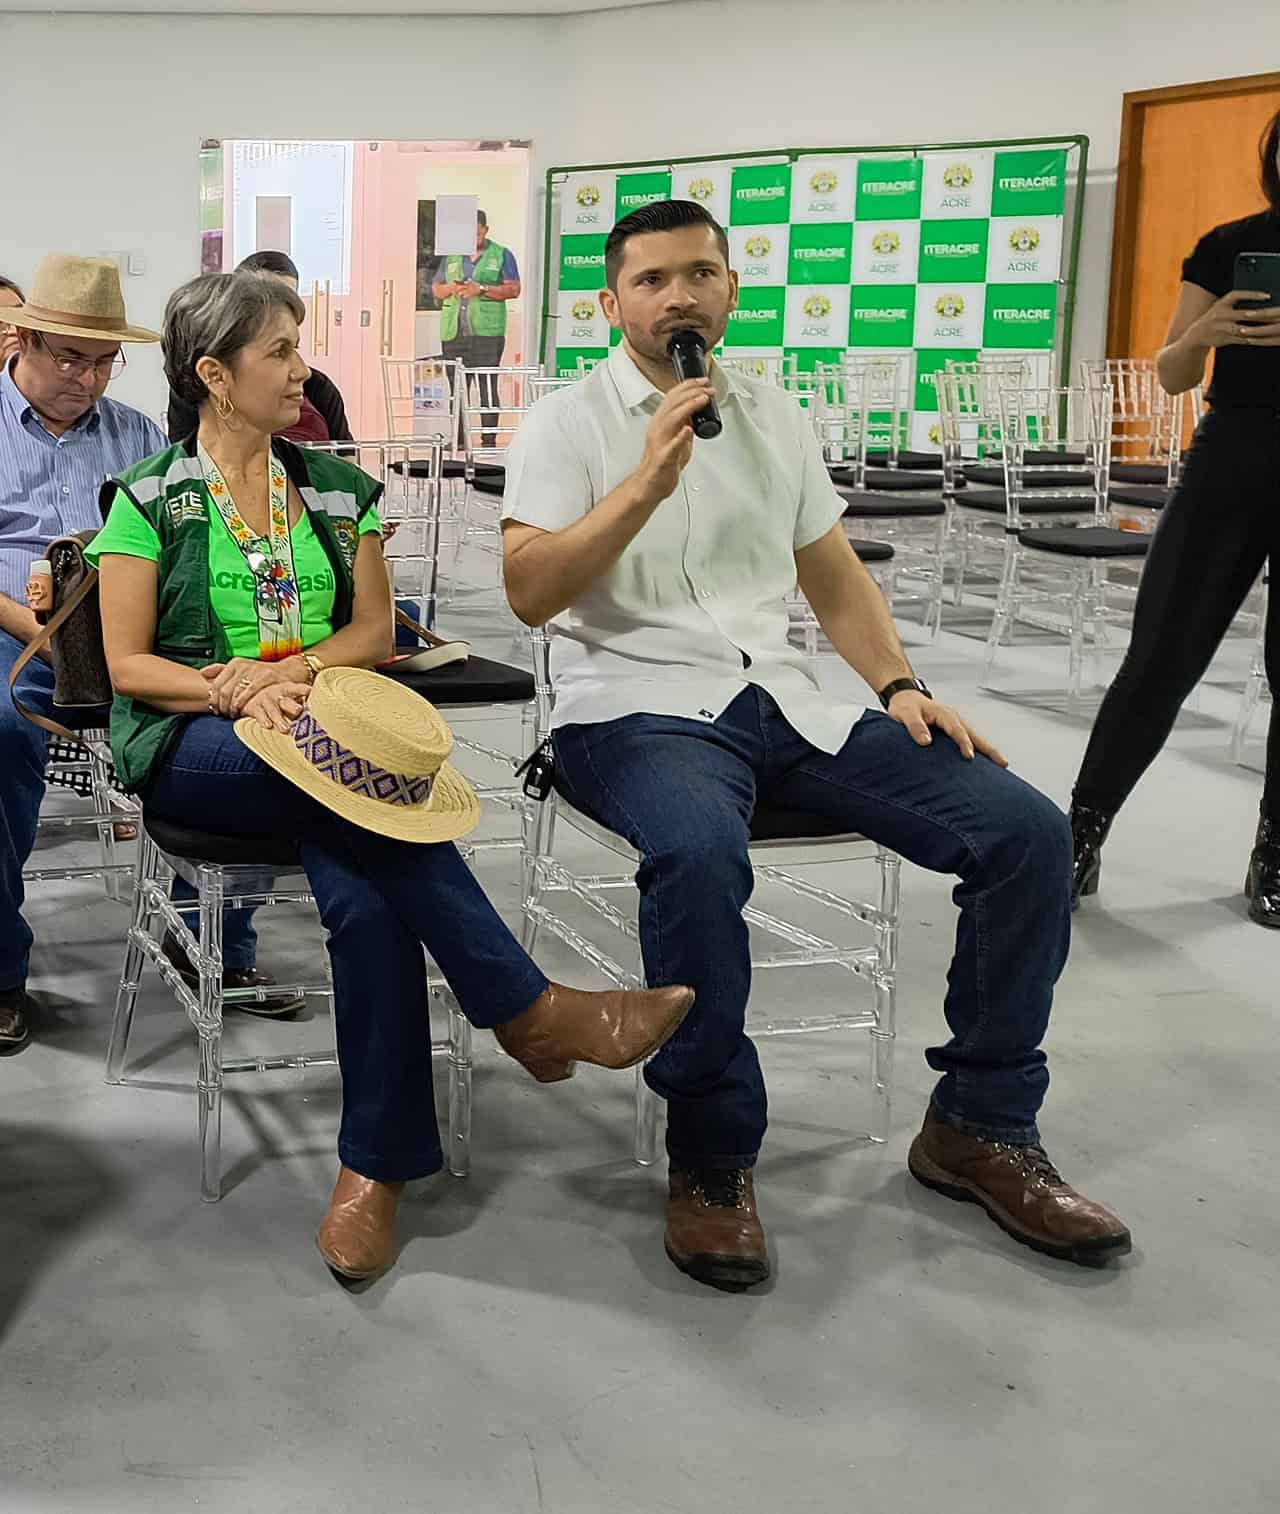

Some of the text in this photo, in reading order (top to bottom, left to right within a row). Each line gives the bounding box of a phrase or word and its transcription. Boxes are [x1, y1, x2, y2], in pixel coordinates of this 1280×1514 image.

[862, 181, 916, 193] ITERACRE
[1000, 176, 1057, 188] ITERACRE
[736, 186, 785, 198] ITERACRE
[621, 192, 667, 205] ITERACRE
[940, 199, 970, 208] ACRE
[794, 247, 846, 259] ITERACRE
[924, 243, 980, 255] ITERACRE
[869, 263, 898, 273] ACRE
[1007, 262, 1039, 272] ACRE
[854, 309, 908, 320] ITERACRE
[993, 309, 1051, 320] ITERACRE
[801, 328, 830, 337] ACRE
[933, 327, 964, 337] ACRE
[165, 491, 202, 516] ETE
